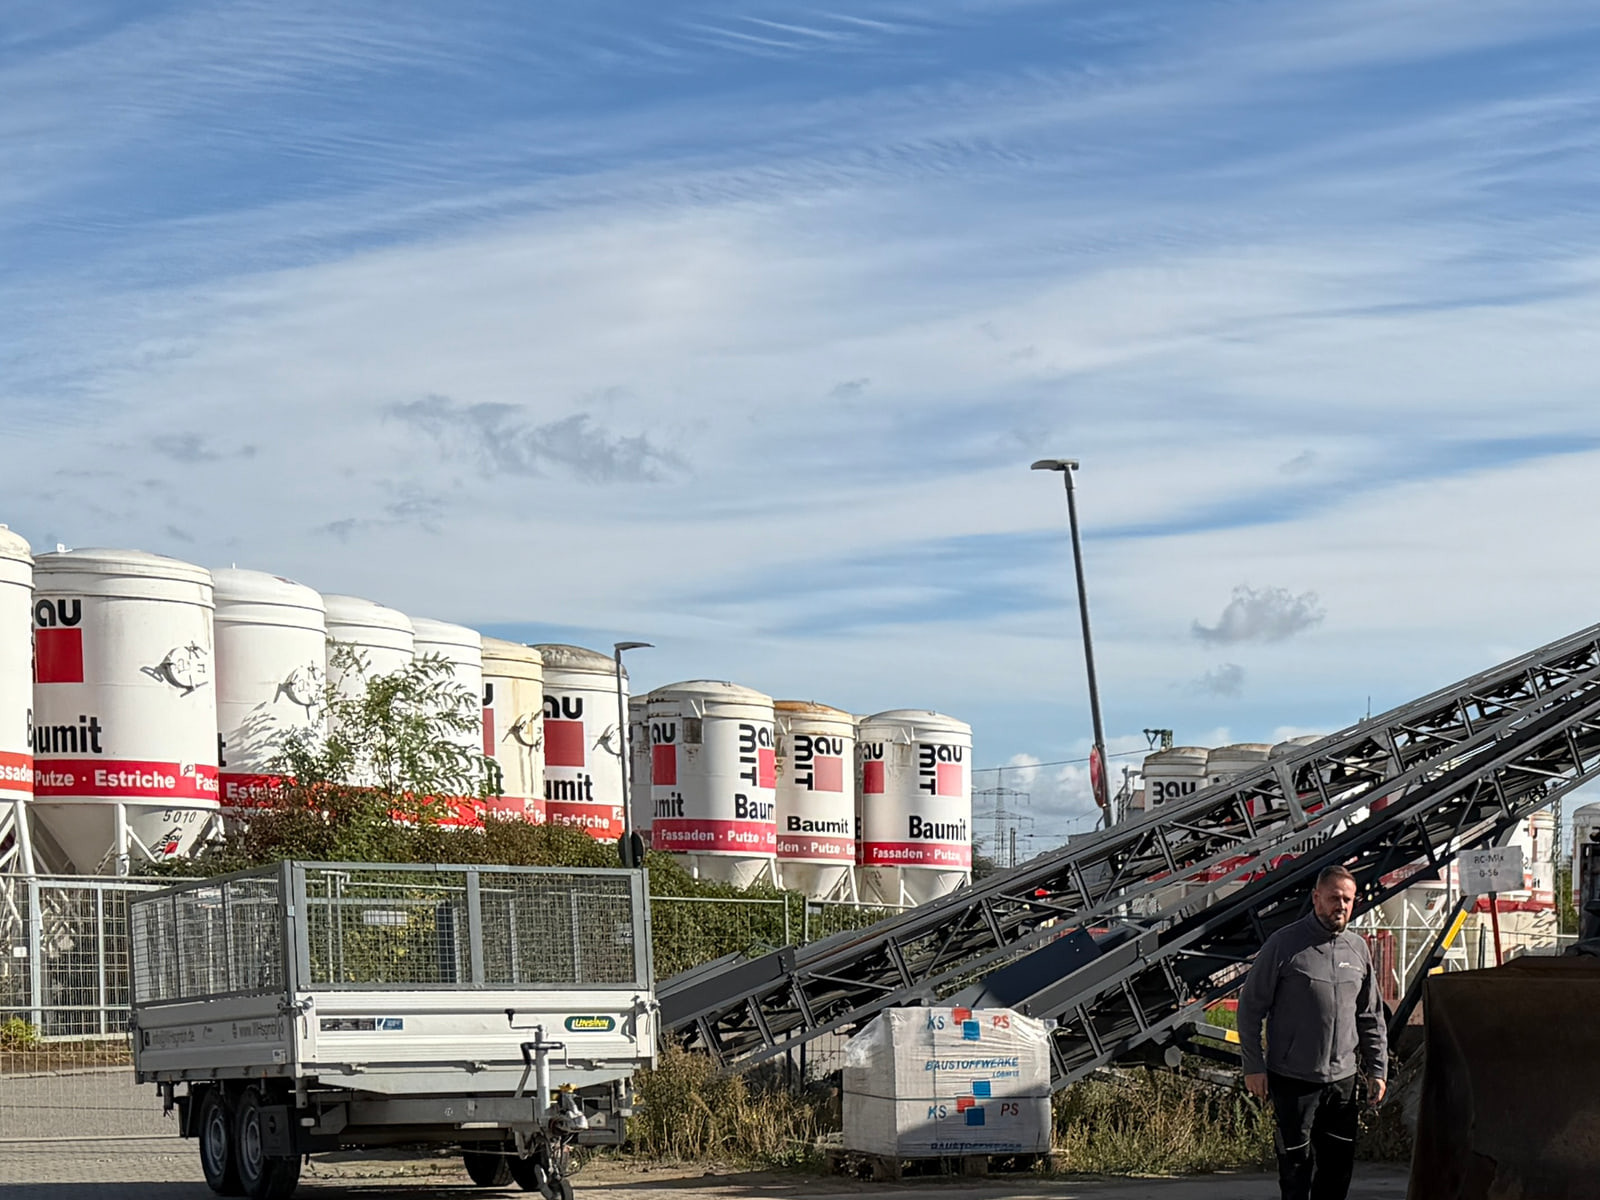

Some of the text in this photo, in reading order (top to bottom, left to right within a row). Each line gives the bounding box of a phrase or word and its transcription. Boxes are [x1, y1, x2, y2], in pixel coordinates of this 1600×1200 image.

[35, 769, 75, 787] Putze
[94, 769, 176, 789] Estriche
[162, 809, 198, 824] 5010
[787, 815, 849, 834] Baumit
[661, 829, 715, 841] Fassaden
[727, 830, 759, 843] Putze
[908, 815, 967, 842] Baumit
[810, 842, 841, 855] Putze
[872, 847, 924, 859] Fassaden
[926, 1014, 1011, 1031] KS PS
[925, 1056, 1019, 1072] BAUSTOFFWERKE
[927, 1102, 1020, 1120] KS PS
